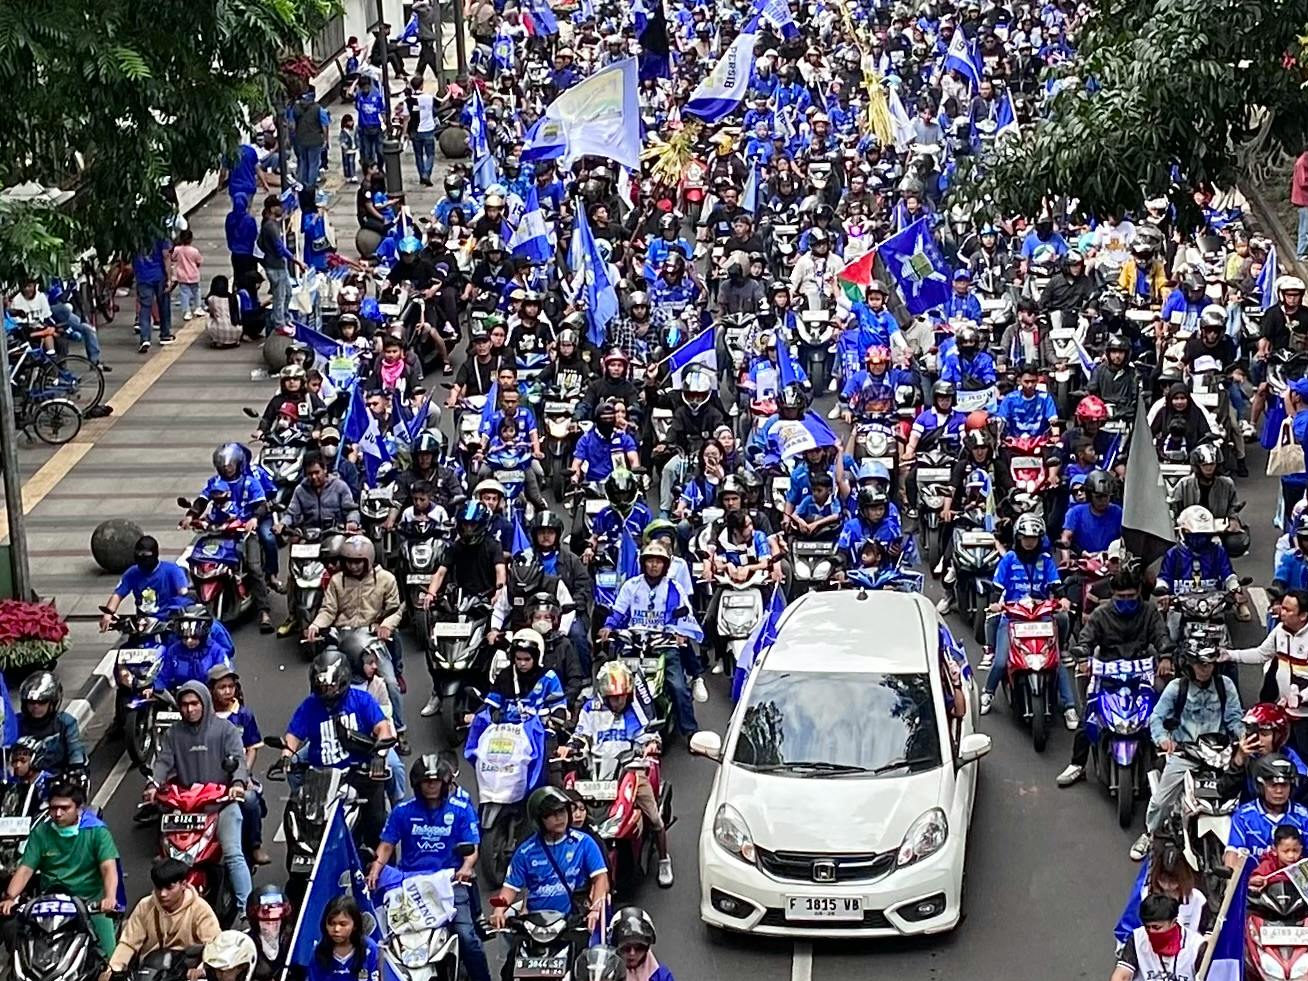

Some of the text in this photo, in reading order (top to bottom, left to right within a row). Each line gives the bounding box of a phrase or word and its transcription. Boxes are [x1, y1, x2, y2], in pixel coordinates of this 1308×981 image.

[789, 898, 860, 911] F 1815 VB
